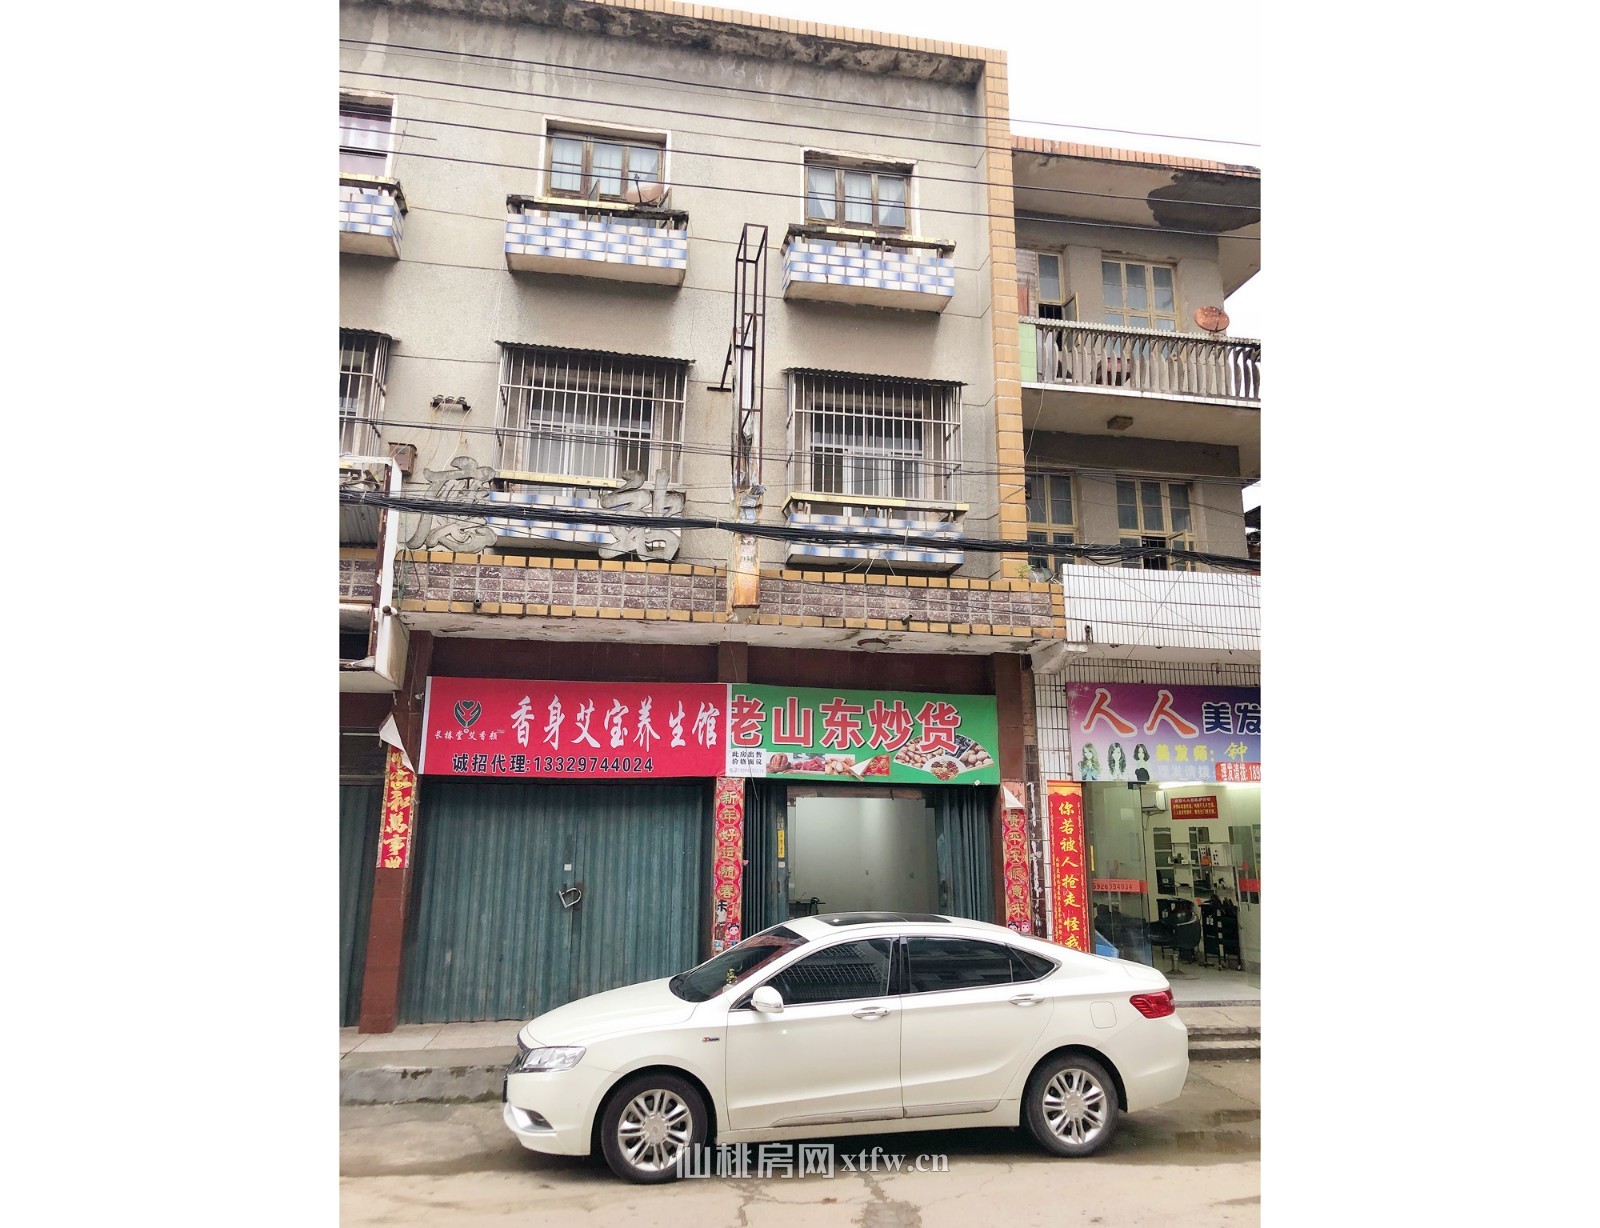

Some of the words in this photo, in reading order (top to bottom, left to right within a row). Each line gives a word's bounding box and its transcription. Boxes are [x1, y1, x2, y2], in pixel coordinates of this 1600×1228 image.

[510, 694, 720, 753] 香身艾宝养生馆
[730, 694, 962, 755] 老山东炒货
[1081, 687, 1261, 738] 人人美发
[453, 753, 653, 773] 诚招代理:13329744024
